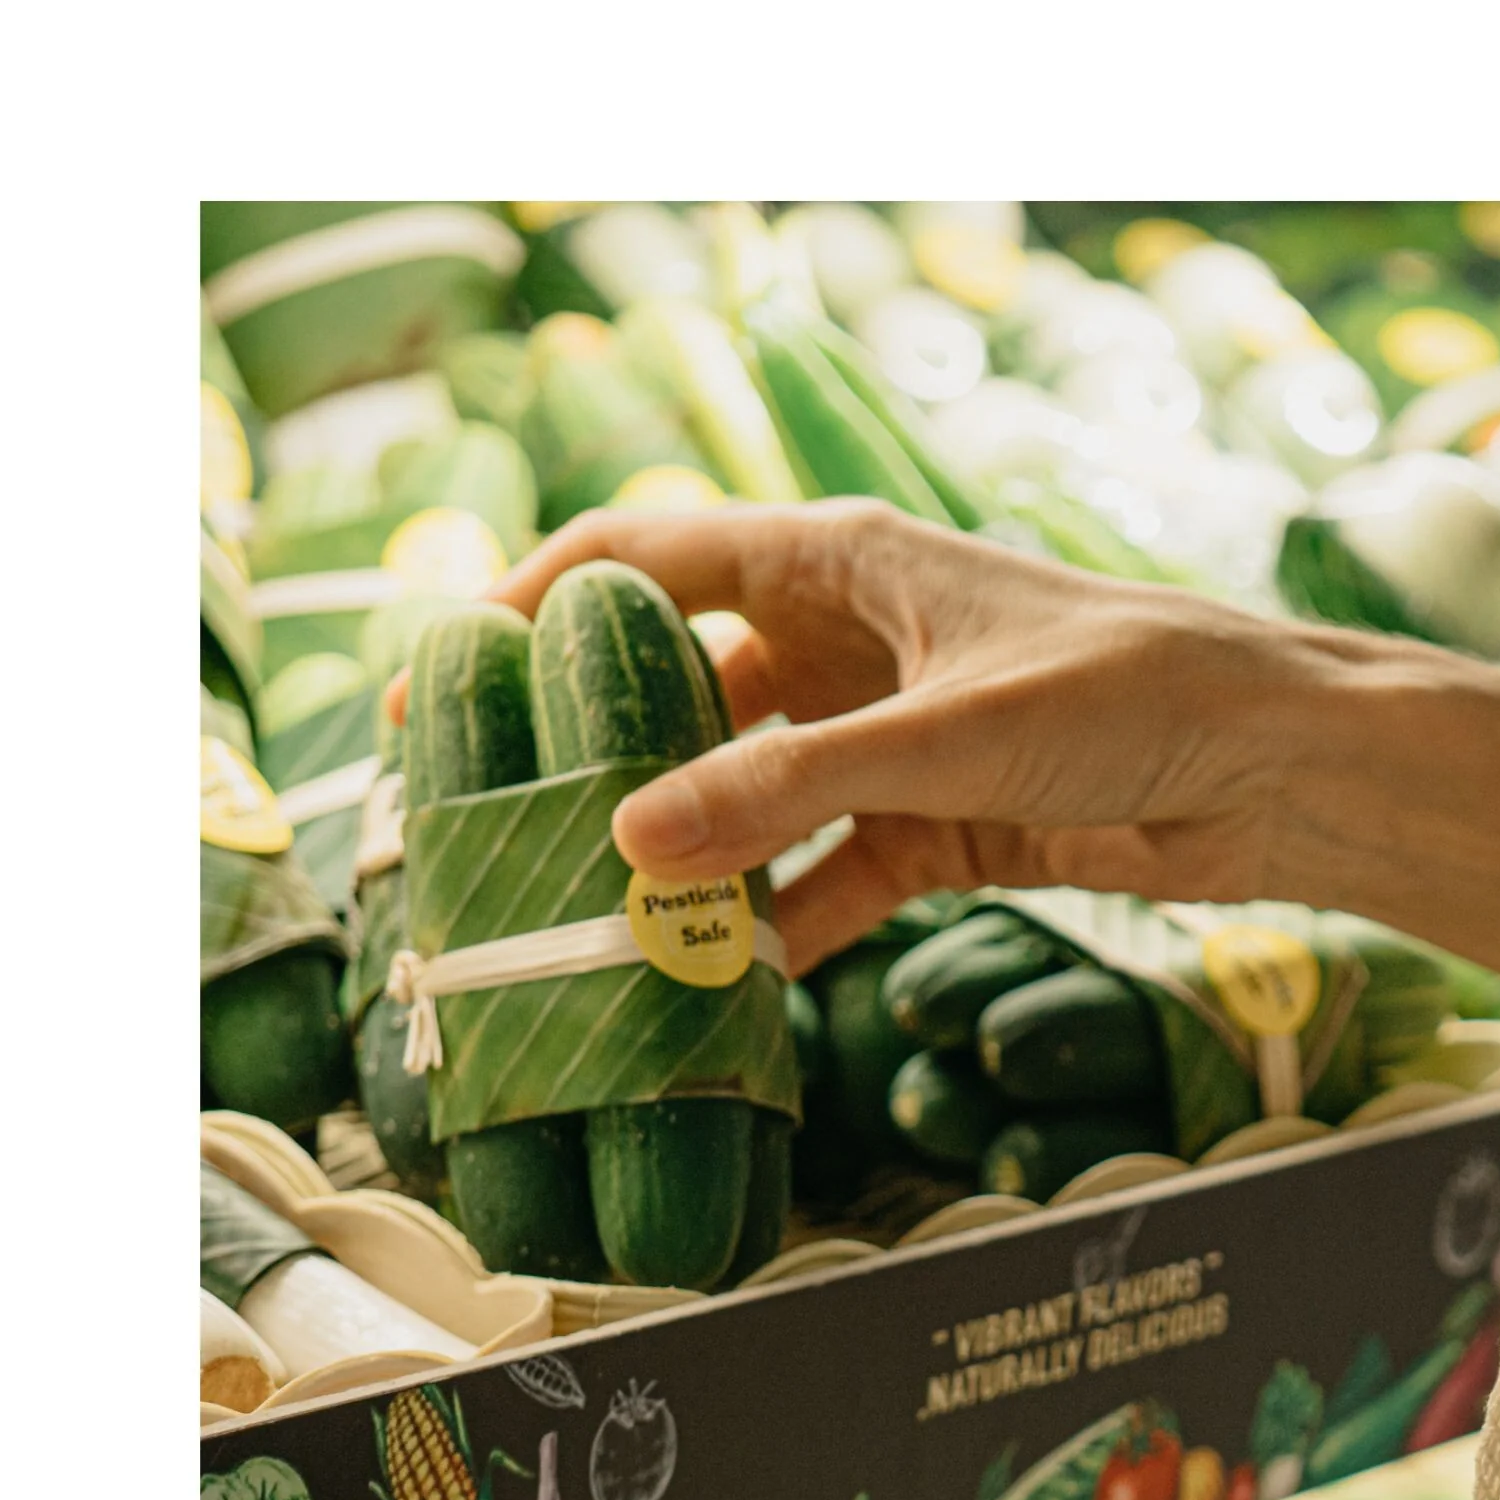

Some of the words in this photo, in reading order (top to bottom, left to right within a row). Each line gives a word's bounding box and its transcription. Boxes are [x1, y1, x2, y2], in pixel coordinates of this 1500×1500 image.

[681, 919, 730, 946] Safe
[927, 1337, 1083, 1413] NATURALLY
[1087, 1293, 1228, 1371] DELICIOUS
[954, 1292, 1075, 1362] VIBRANT
[1079, 1258, 1201, 1327] FLAVORS
